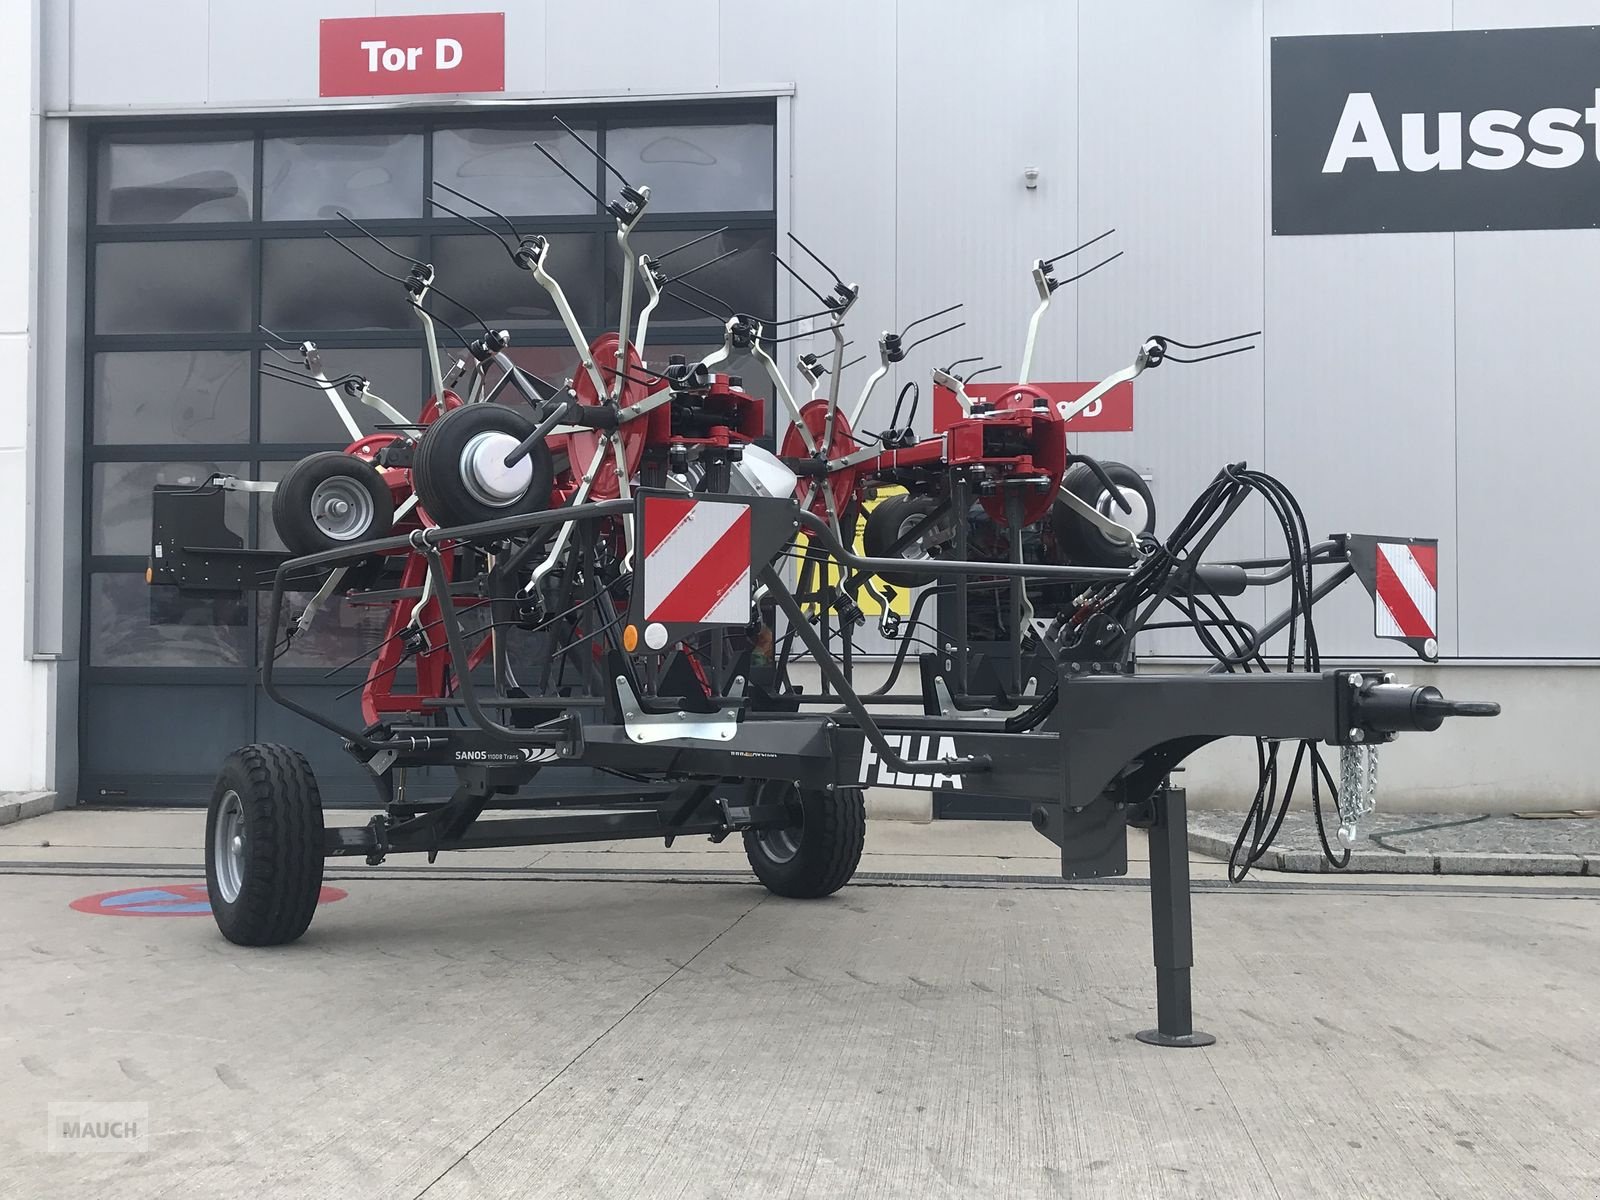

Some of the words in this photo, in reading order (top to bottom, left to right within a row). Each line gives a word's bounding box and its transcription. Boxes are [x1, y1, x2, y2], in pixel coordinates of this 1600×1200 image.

[361, 40, 423, 72] Tor
[436, 38, 463, 70] D
[455, 751, 487, 760] SANOS
